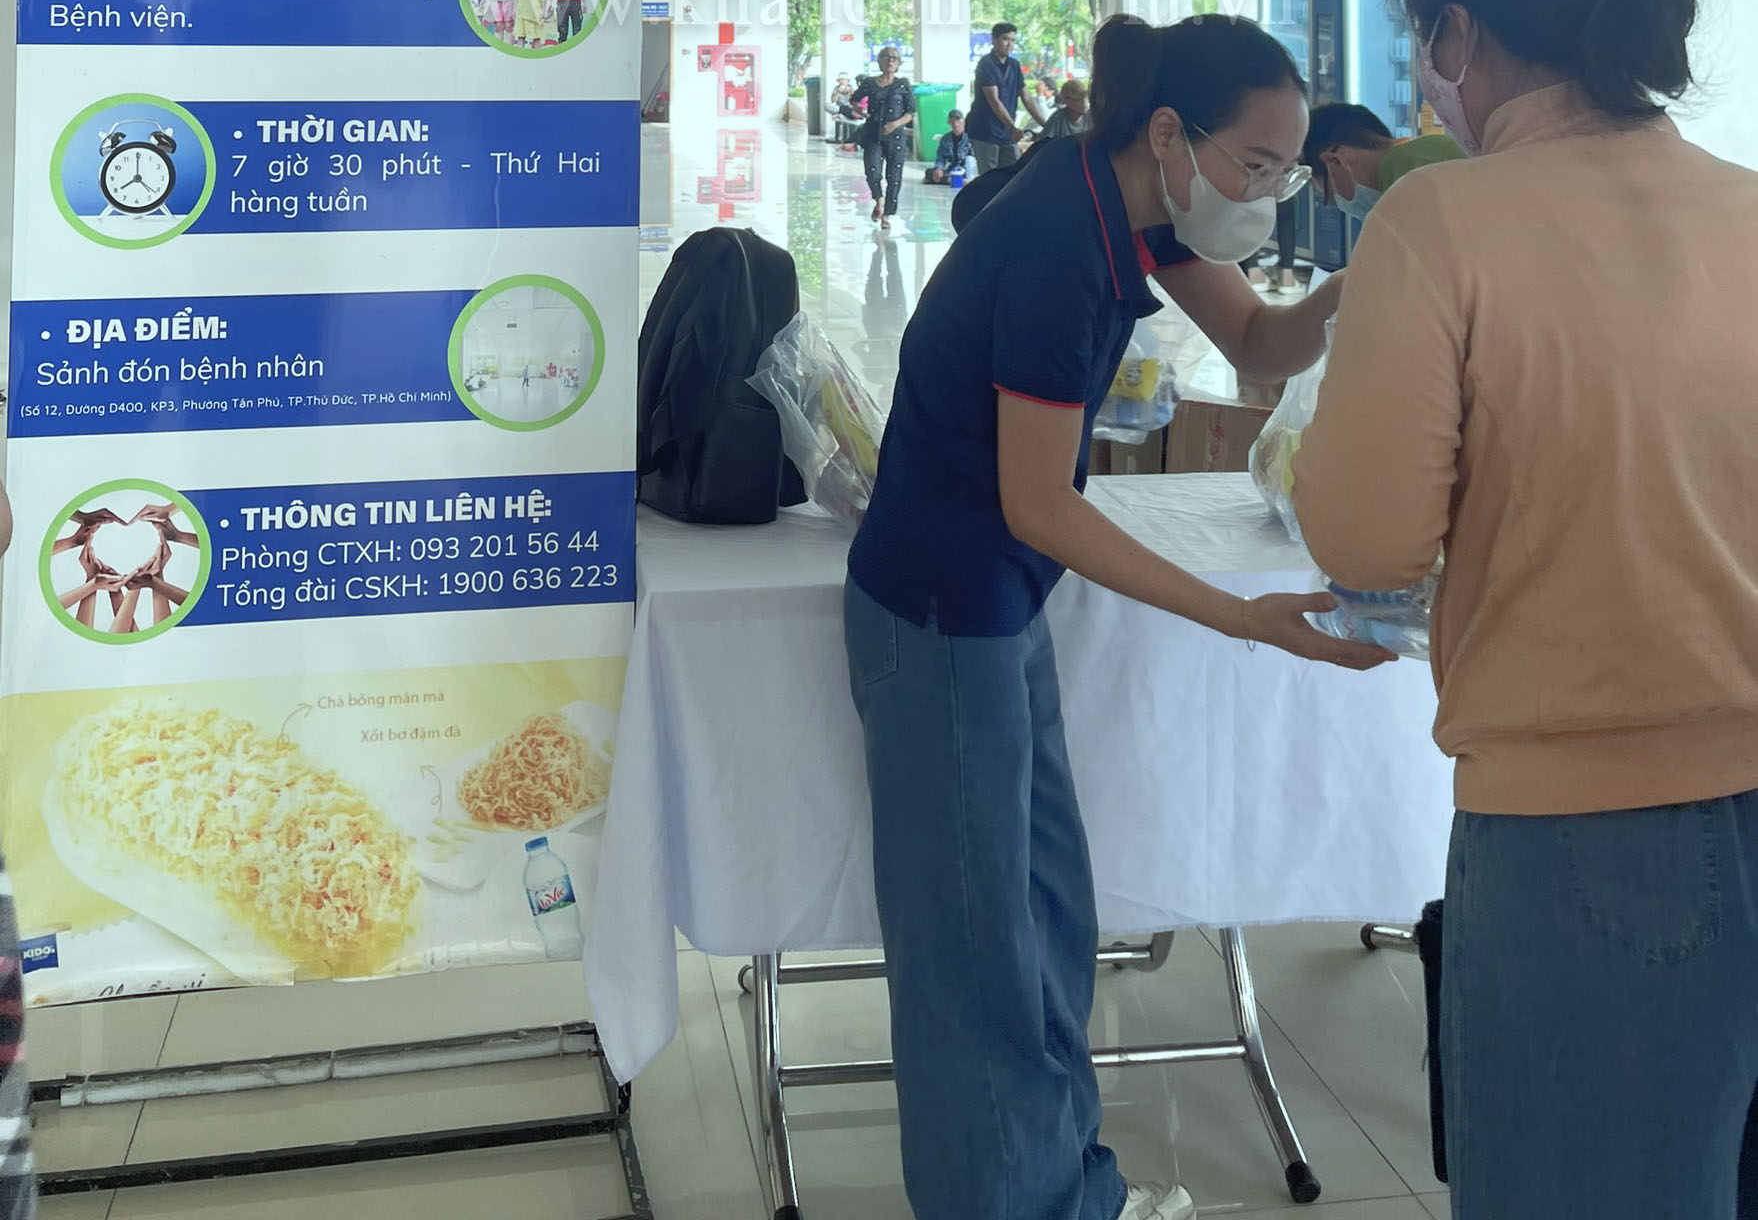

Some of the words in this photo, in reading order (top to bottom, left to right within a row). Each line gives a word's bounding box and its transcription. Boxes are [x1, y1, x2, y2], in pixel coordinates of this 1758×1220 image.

[50, 4, 121, 32] Bệnh
[131, 5, 193, 32] viện.
[257, 114, 334, 143] THỜI
[343, 119, 429, 143] GIAN:
[231, 155, 248, 178] 7
[268, 155, 309, 182] giờ
[329, 154, 363, 177] 30
[382, 153, 442, 181] phút
[490, 151, 540, 174] Thứ
[558, 152, 601, 173] Hai
[231, 191, 298, 218] hàng
[307, 186, 367, 212] tuần
[67, 318, 126, 349] ĐỊA
[134, 306, 227, 342] ĐIỂM:
[36, 360, 108, 386] Sảnh
[118, 357, 170, 383] đón
[180, 355, 247, 385] bệnh
[256, 353, 324, 378] nhân
[20, 405, 40, 418] (Số
[45, 405, 62, 417] 12,
[66, 404, 105, 416] Đường
[109, 402, 147, 414] D400,
[151, 401, 178, 412] KP3,
[183, 399, 228, 412] Phường
[232, 397, 253, 409] Tân
[257, 396, 283, 408] Phú,
[288, 394, 328, 407] TP.Thủ
[332, 393, 357, 406] Đức,
[362, 391, 395, 404] TP.Hồ
[399, 391, 417, 402] Chí
[420, 390, 451, 402] Minh)
[240, 499, 356, 531] THÔNG
[364, 500, 416, 525] TIN
[426, 492, 496, 522] LIÊN
[504, 488, 552, 524] HỆ:
[222, 544, 308, 573] Phòng
[318, 540, 401, 565] CTXH:
[410, 536, 460, 561] 093
[469, 534, 517, 558] 201
[527, 532, 559, 555] 56
[567, 530, 600, 553] 44
[216, 580, 286, 610] Tổng
[295, 577, 336, 603] đài
[345, 574, 428, 600] CSKH:
[439, 570, 504, 595] 1900
[512, 567, 561, 591] 636
[570, 564, 618, 589] 223
